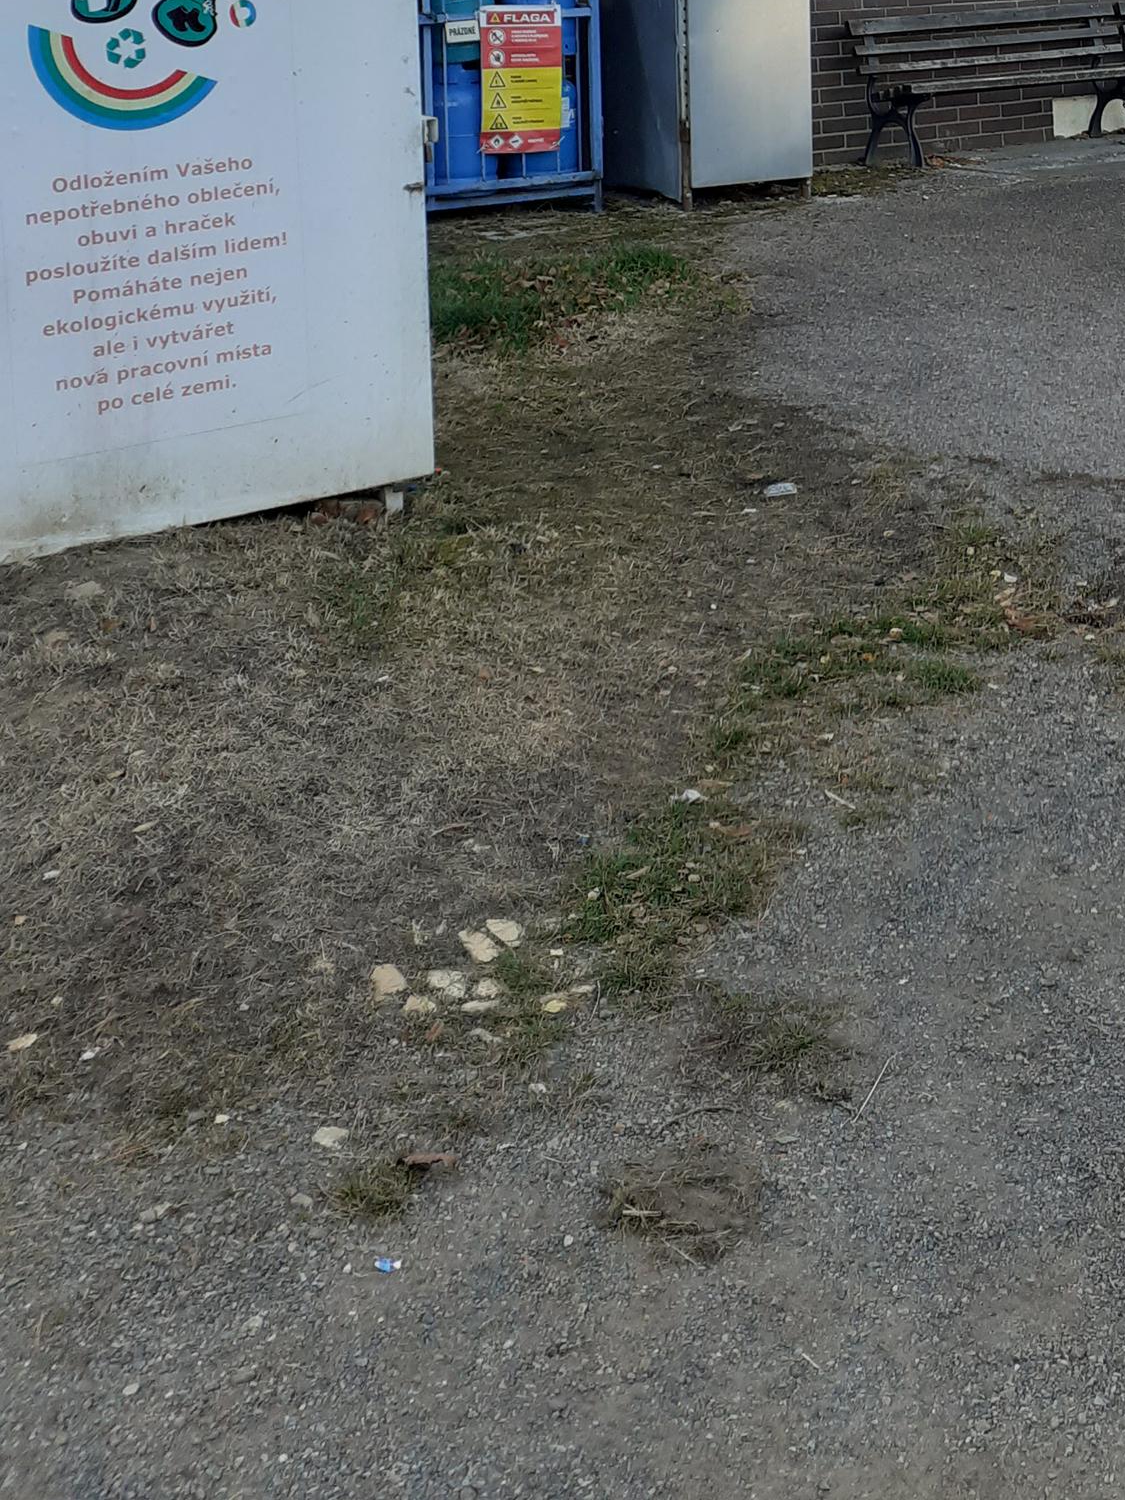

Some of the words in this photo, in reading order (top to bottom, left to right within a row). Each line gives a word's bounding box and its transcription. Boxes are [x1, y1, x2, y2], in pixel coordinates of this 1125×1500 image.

[503, 13, 551, 23] FLAGA
[52, 166, 169, 193] Odložením
[176, 156, 253, 178] Vašeho
[25, 192, 180, 226] nepotřebného
[188, 178, 281, 204] oblečení,
[78, 224, 137, 247] obuvi
[145, 226, 157, 238] a
[165, 212, 236, 235] hraček
[25, 253, 140, 286] posloužíte
[148, 242, 217, 266] dalším
[224, 231, 288, 255] lidem!
[73, 276, 182, 304] Pomáháte
[190, 266, 248, 287] nejen
[43, 304, 195, 337] ekologickému
[202, 285, 277, 315] využití,
[93, 340, 126, 357] ale
[146, 321, 235, 349] vytvářet
[55, 369, 108, 391] nová
[117, 350, 208, 384] pracovní
[216, 342, 272, 364] místa
[97, 396, 124, 415] po
[132, 383, 173, 406] celé
[181, 374, 237, 398] zemi.
